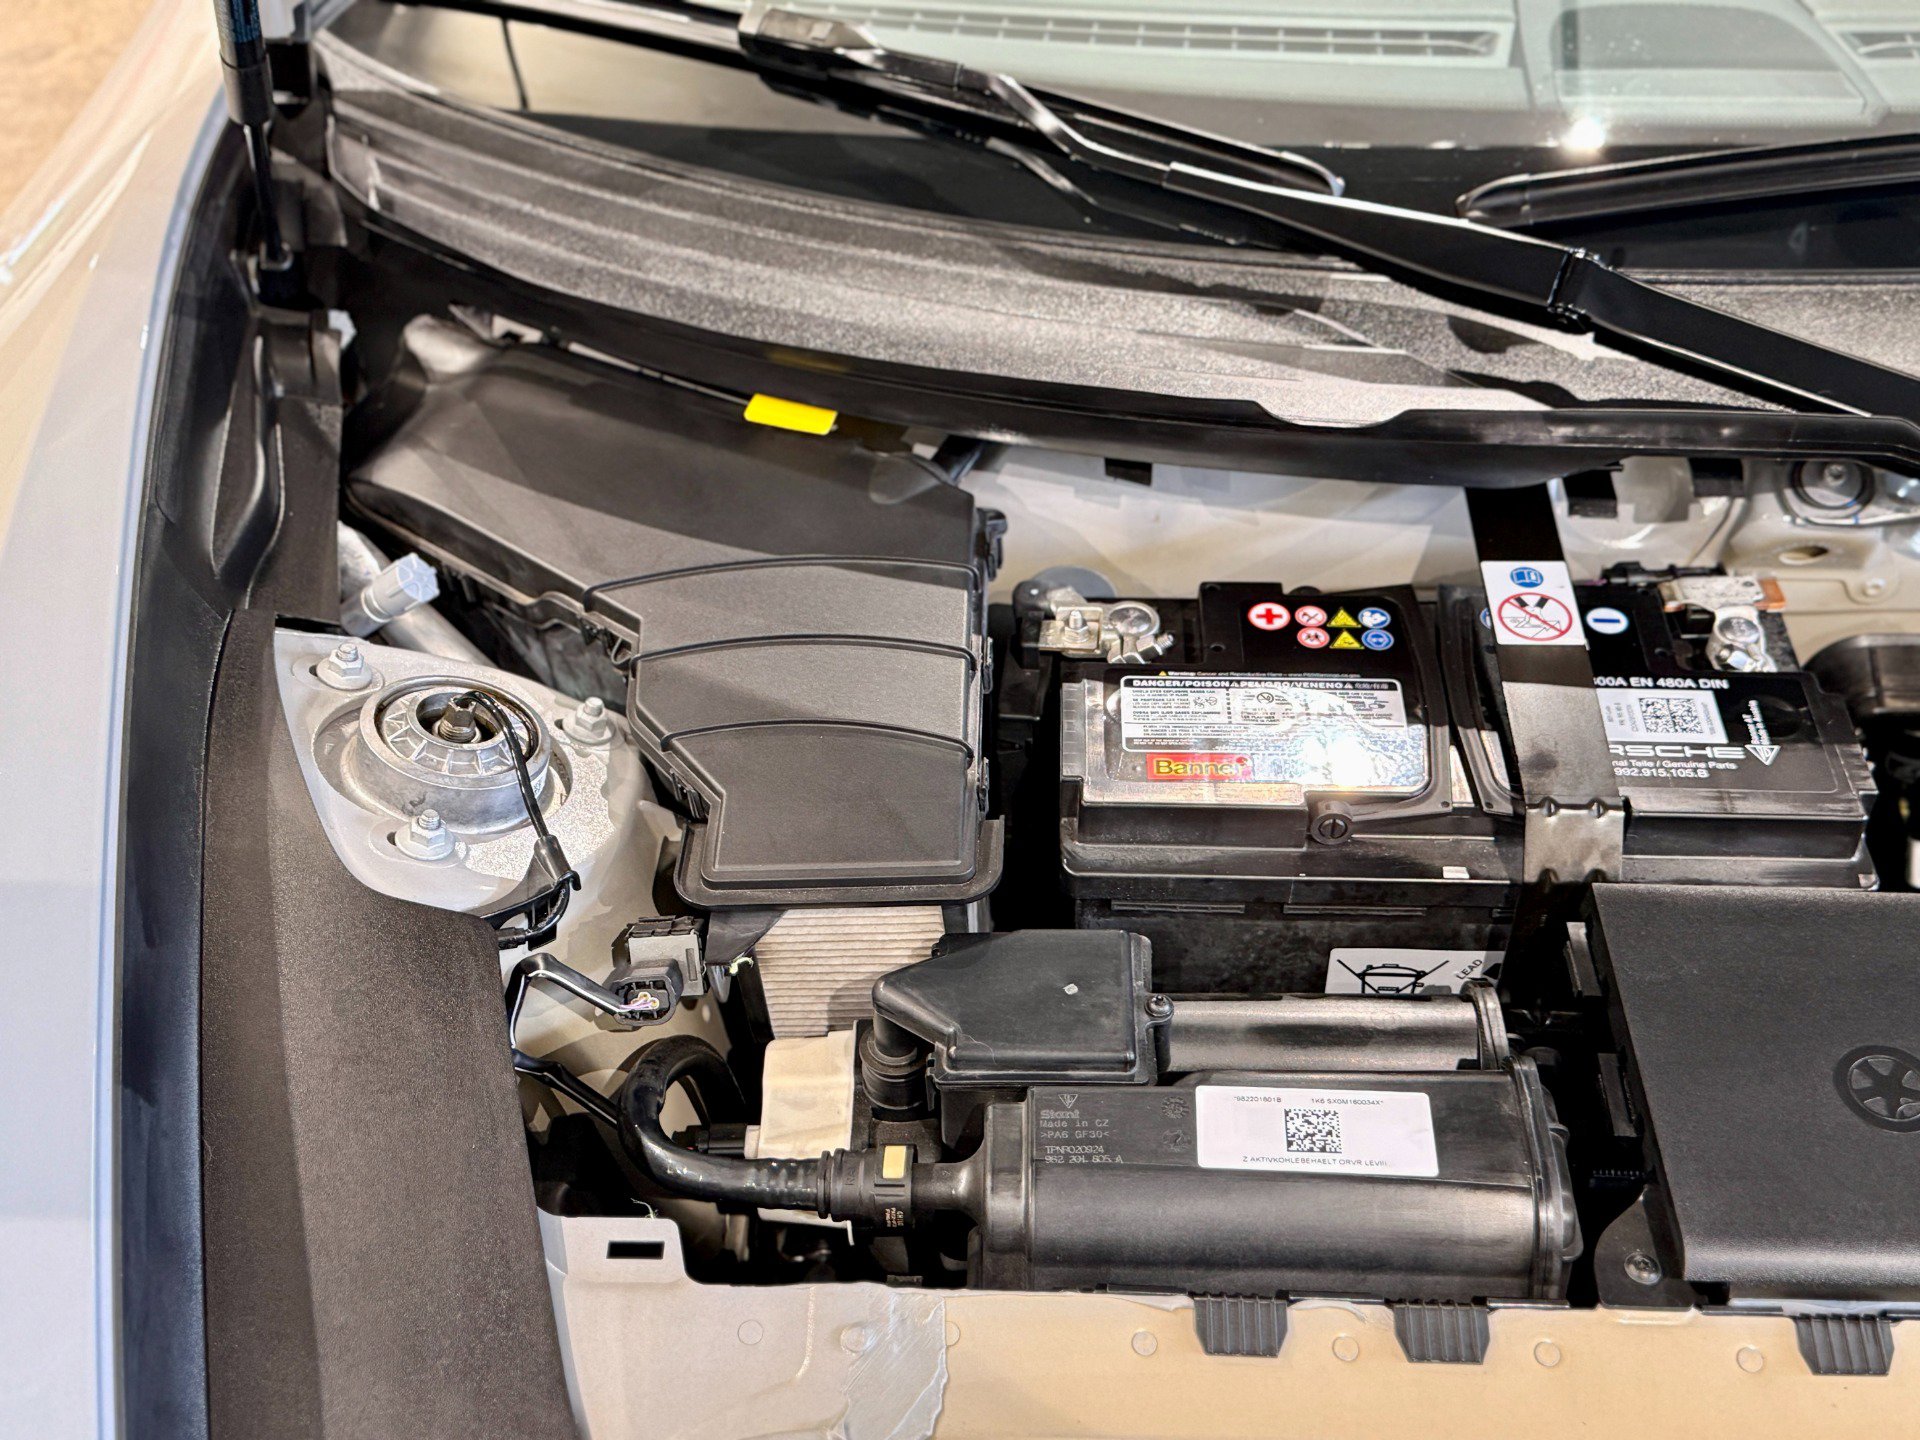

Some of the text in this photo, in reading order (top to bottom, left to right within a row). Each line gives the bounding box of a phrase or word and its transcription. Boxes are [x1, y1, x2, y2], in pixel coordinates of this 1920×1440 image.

[1240, 681, 1344, 689] PELIGRO/VENENO
[1594, 676, 1729, 689] 00A EN 480A DIN
[1609, 745, 1746, 758] RSCHE
[1629, 760, 1655, 768] Teile
[1662, 760, 1707, 768] Genuine
[1708, 761, 1738, 770] Parts
[1456, 959, 1482, 979] LEAD
[1040, 1120, 1068, 1128] Made
[1095, 1119, 1110, 1128] CZ
